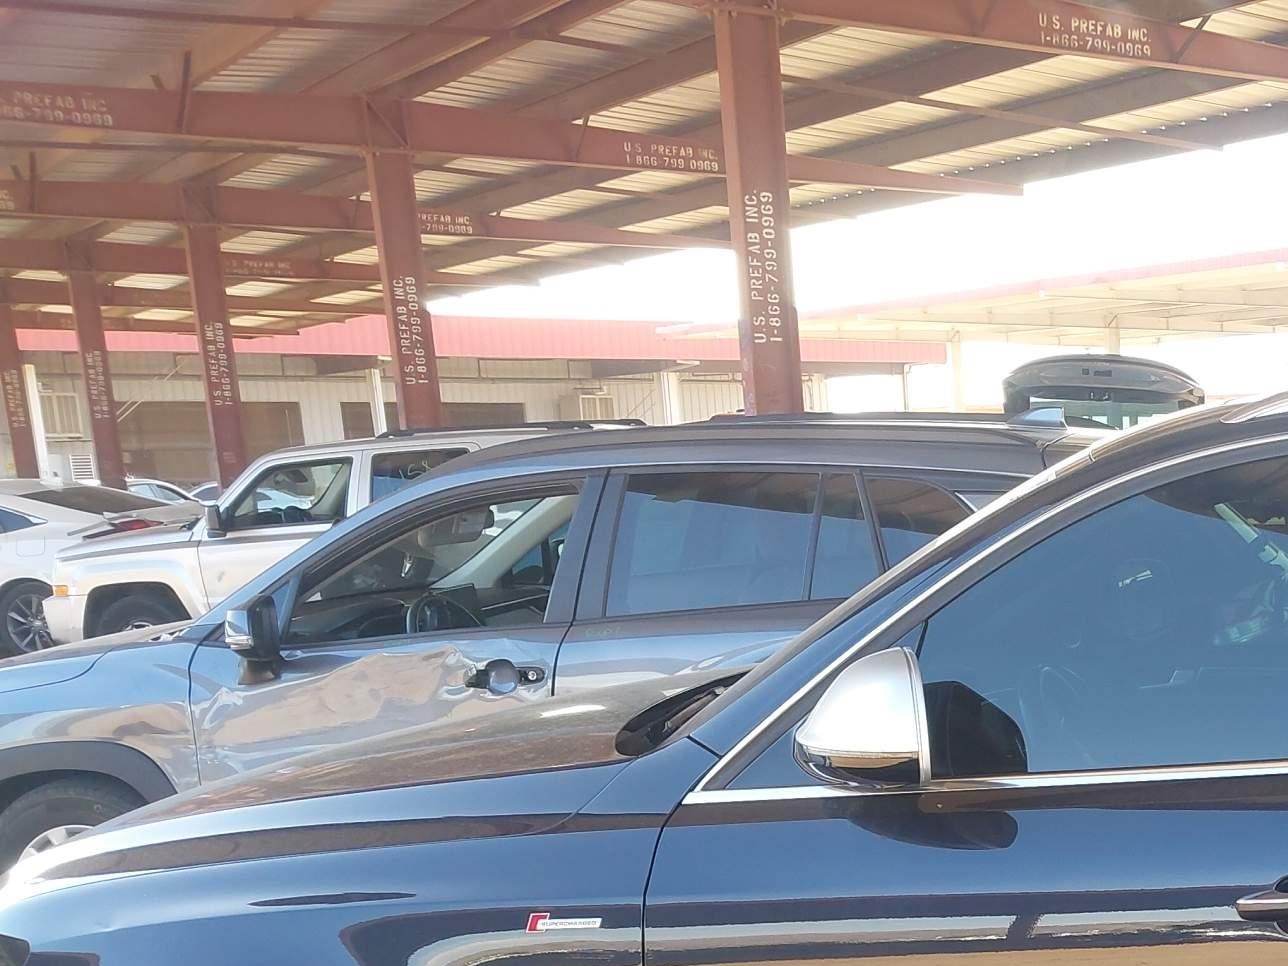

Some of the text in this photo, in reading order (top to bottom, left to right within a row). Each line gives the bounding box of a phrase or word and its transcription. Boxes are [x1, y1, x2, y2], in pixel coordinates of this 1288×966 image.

[1040, 31, 1151, 57] 1-866-799-0969
[1071, 17, 1122, 39] PREFAB
[1127, 27, 1152, 42] INC.
[650, 144, 693, 158] PREFAB
[744, 190, 767, 343] U.S. PREFAB INC.
[760, 191, 783, 342] 1-866-799-0969
[393, 275, 405, 299] INC.
[396, 306, 413, 354] PREFAB
[405, 277, 429, 383] 1-866-799-0969
[207, 345, 220, 383] PREFAB
